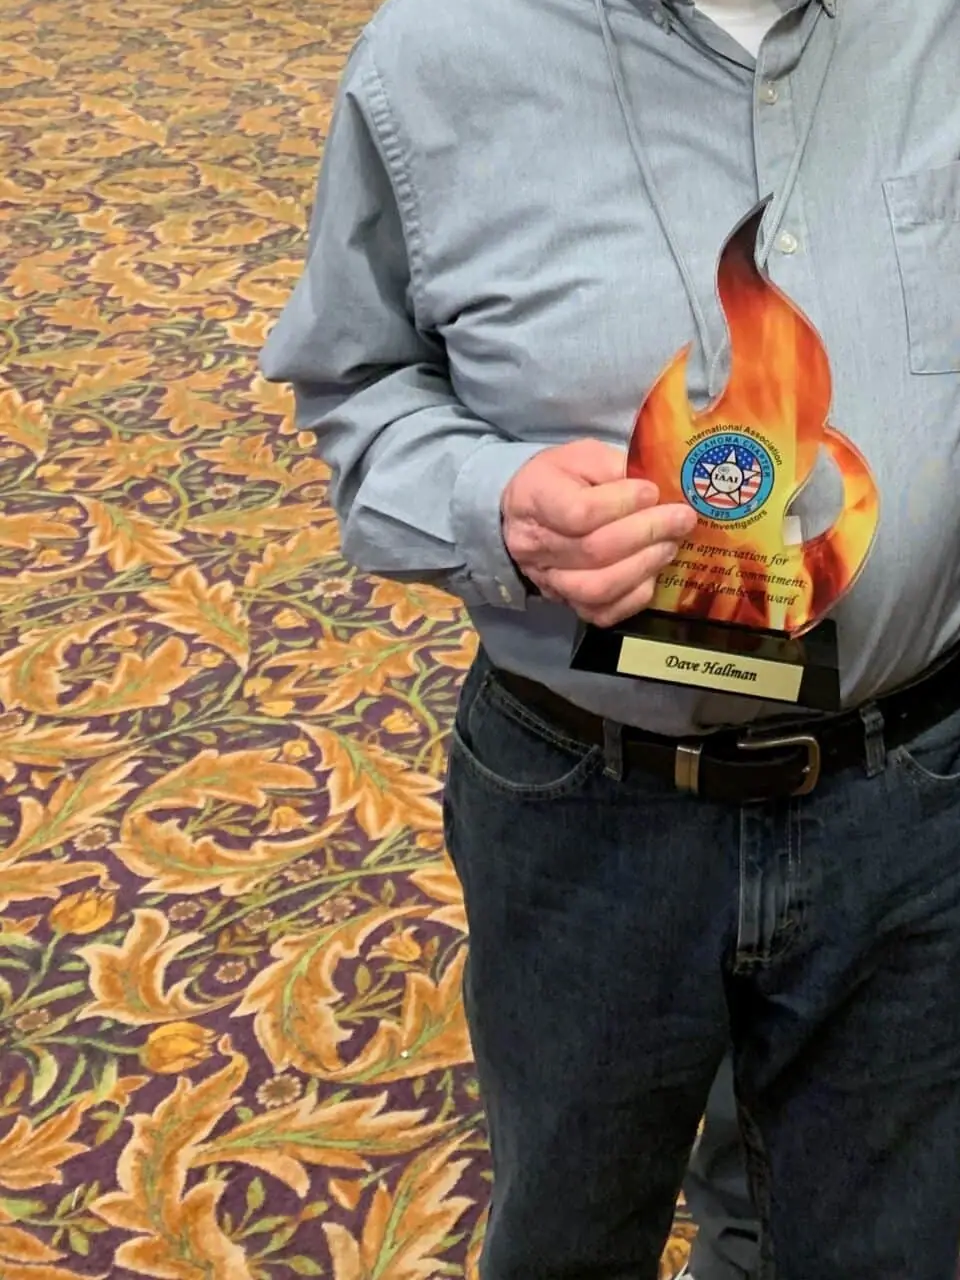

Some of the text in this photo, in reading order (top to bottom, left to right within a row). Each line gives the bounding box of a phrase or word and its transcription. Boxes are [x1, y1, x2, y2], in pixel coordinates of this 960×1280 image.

[686, 423, 783, 466] International Association
[689, 435, 740, 464] OKLAHOMA
[714, 473, 739, 484] IAAI
[710, 509, 768, 530] Investigators
[679, 539, 790, 568] In appreciation for
[656, 573, 706, 589] Lifetime
[710, 565, 734, 576] and
[665, 654, 758, 682] Dave Hallman
